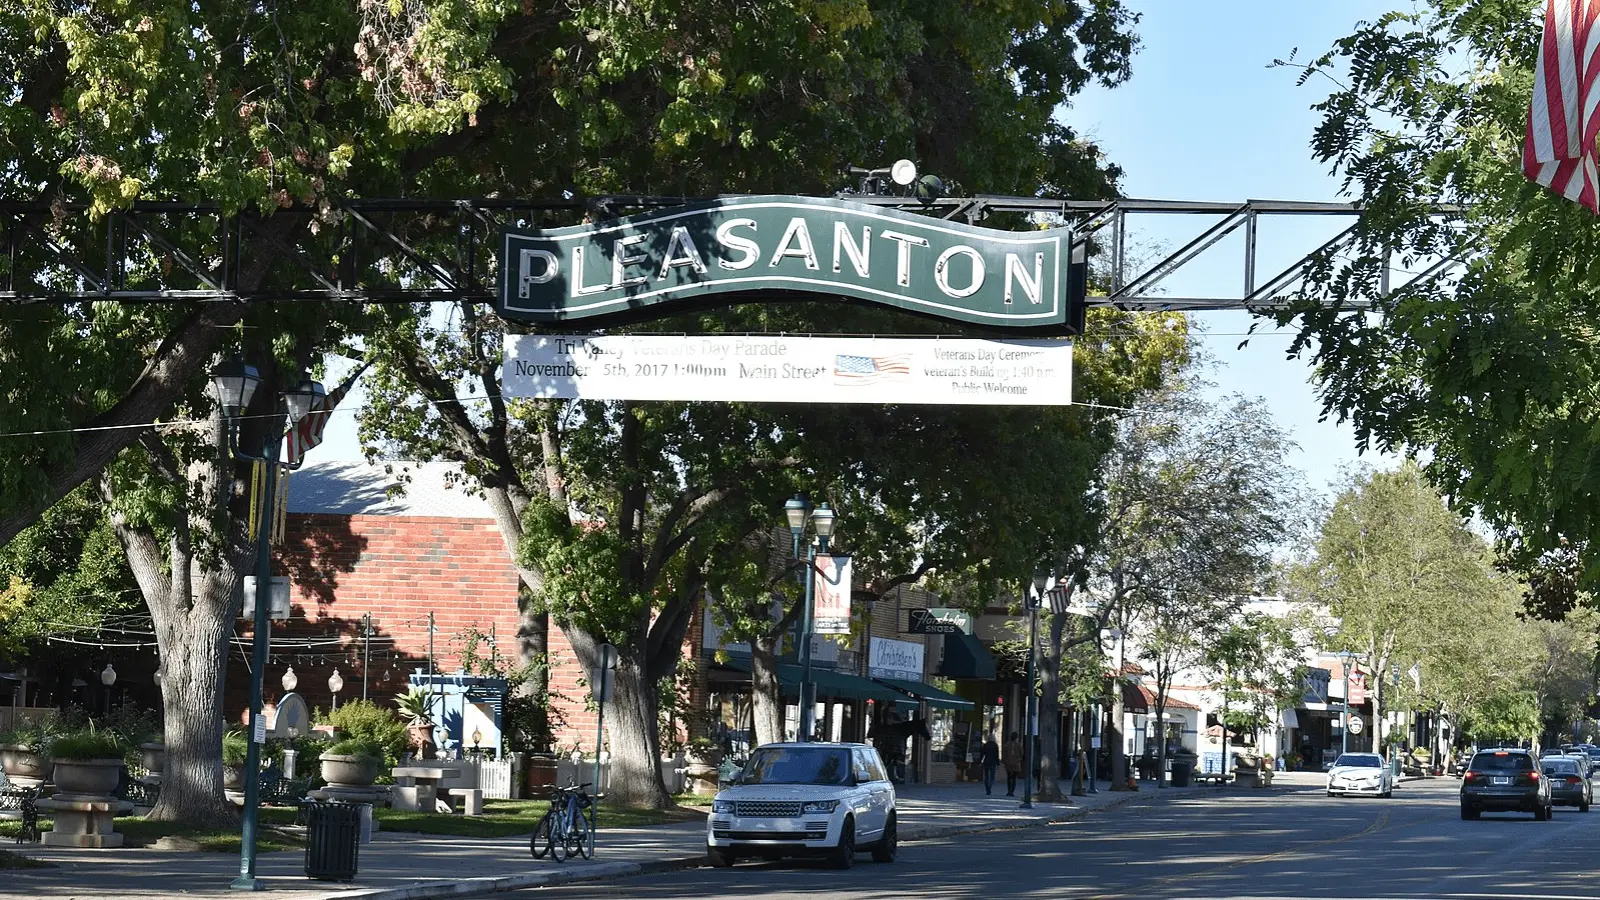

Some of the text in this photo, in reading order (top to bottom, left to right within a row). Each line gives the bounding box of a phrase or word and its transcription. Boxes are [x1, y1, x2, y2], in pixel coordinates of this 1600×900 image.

[518, 217, 1044, 305] PLEASANTON
[555, 338, 576, 354] Tri
[581, 338, 624, 359] Vaey
[701, 339, 730, 360] Day
[735, 339, 787, 356] Parade
[934, 348, 975, 361] Veterans
[978, 348, 997, 363] Day
[515, 360, 591, 377] November
[603, 363, 629, 378] 5th,
[635, 363, 668, 377] 2017
[738, 362, 777, 379] Main
[970, 365, 1009, 380] Buildng
[983, 382, 1028, 395] Welcome
[925, 625, 955, 633] SHOES
